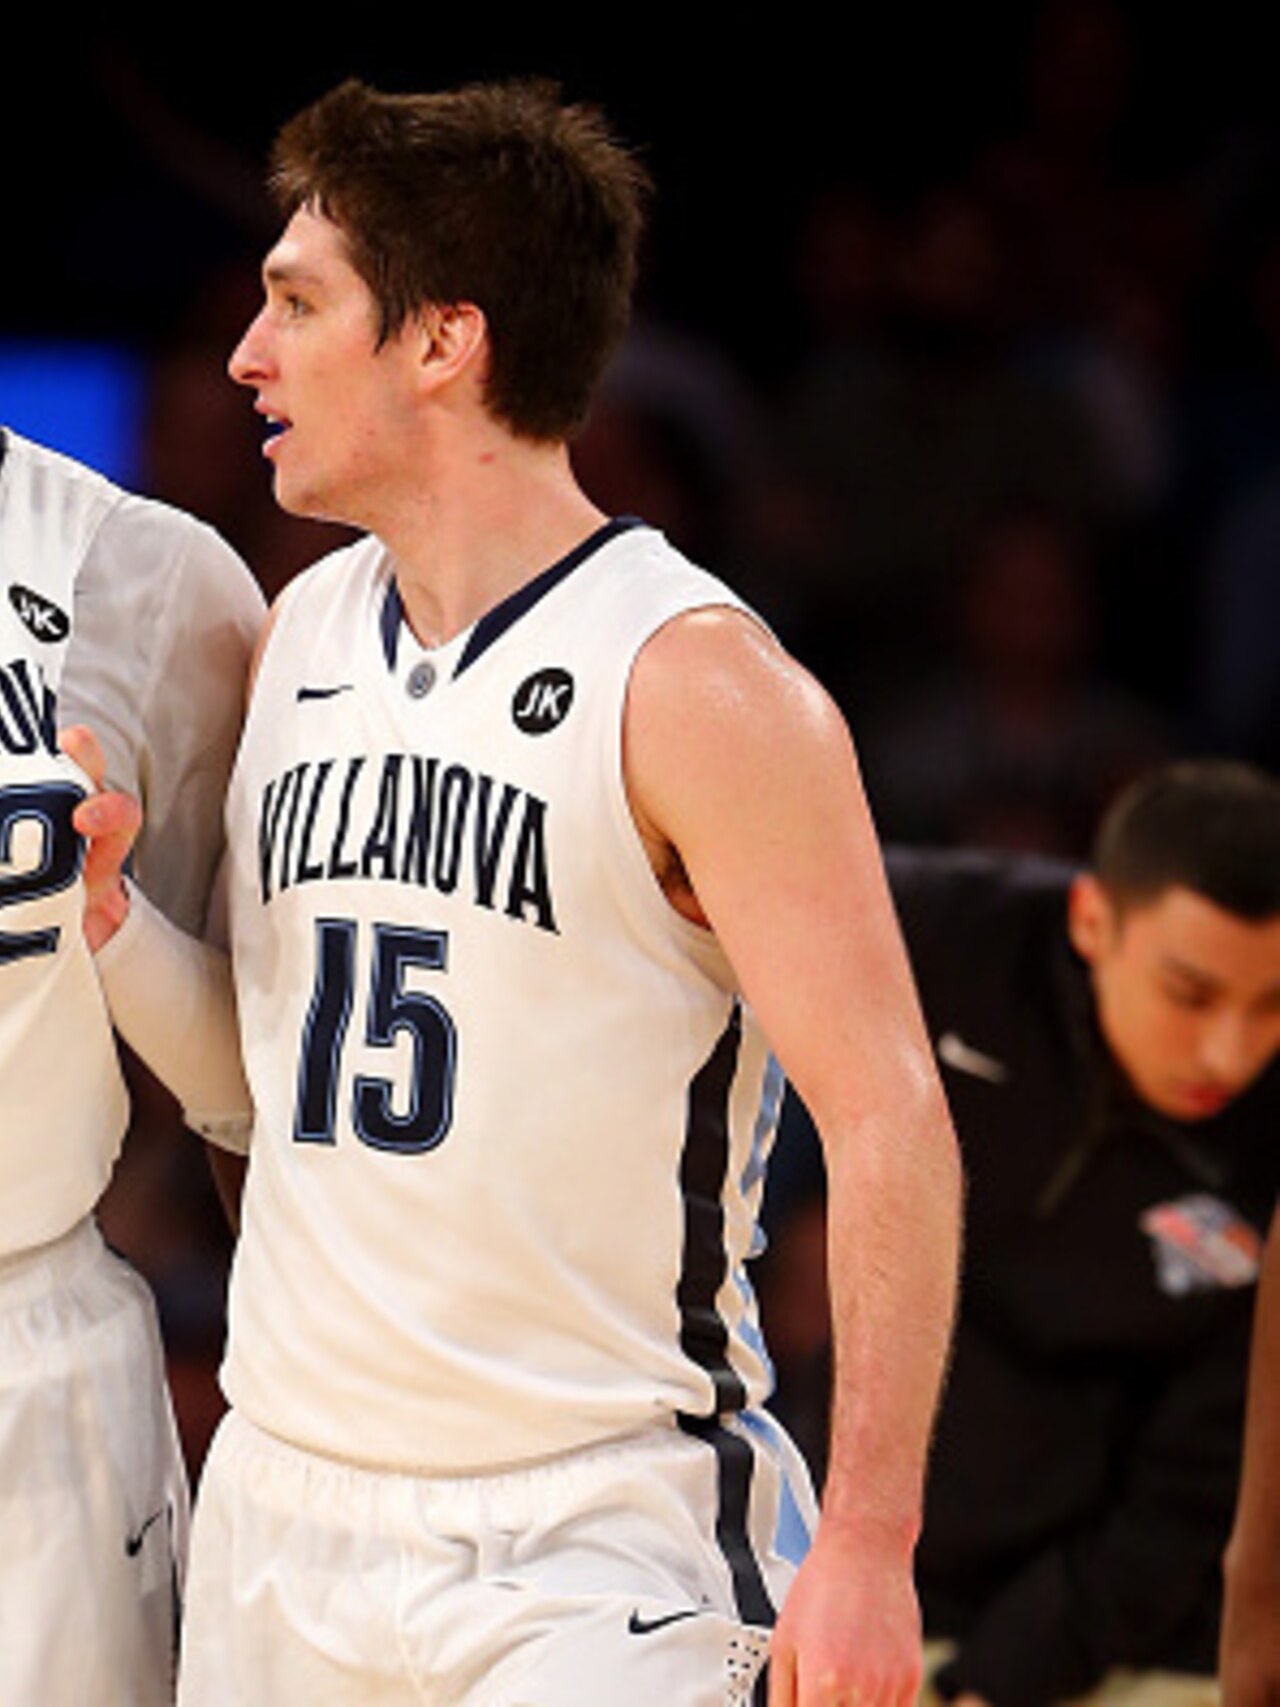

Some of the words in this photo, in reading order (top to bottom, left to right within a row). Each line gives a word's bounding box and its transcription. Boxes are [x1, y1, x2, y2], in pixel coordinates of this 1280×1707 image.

[516, 681, 570, 719] JK
[258, 753, 561, 936] VILLANOVA
[292, 916, 459, 1157] 15
